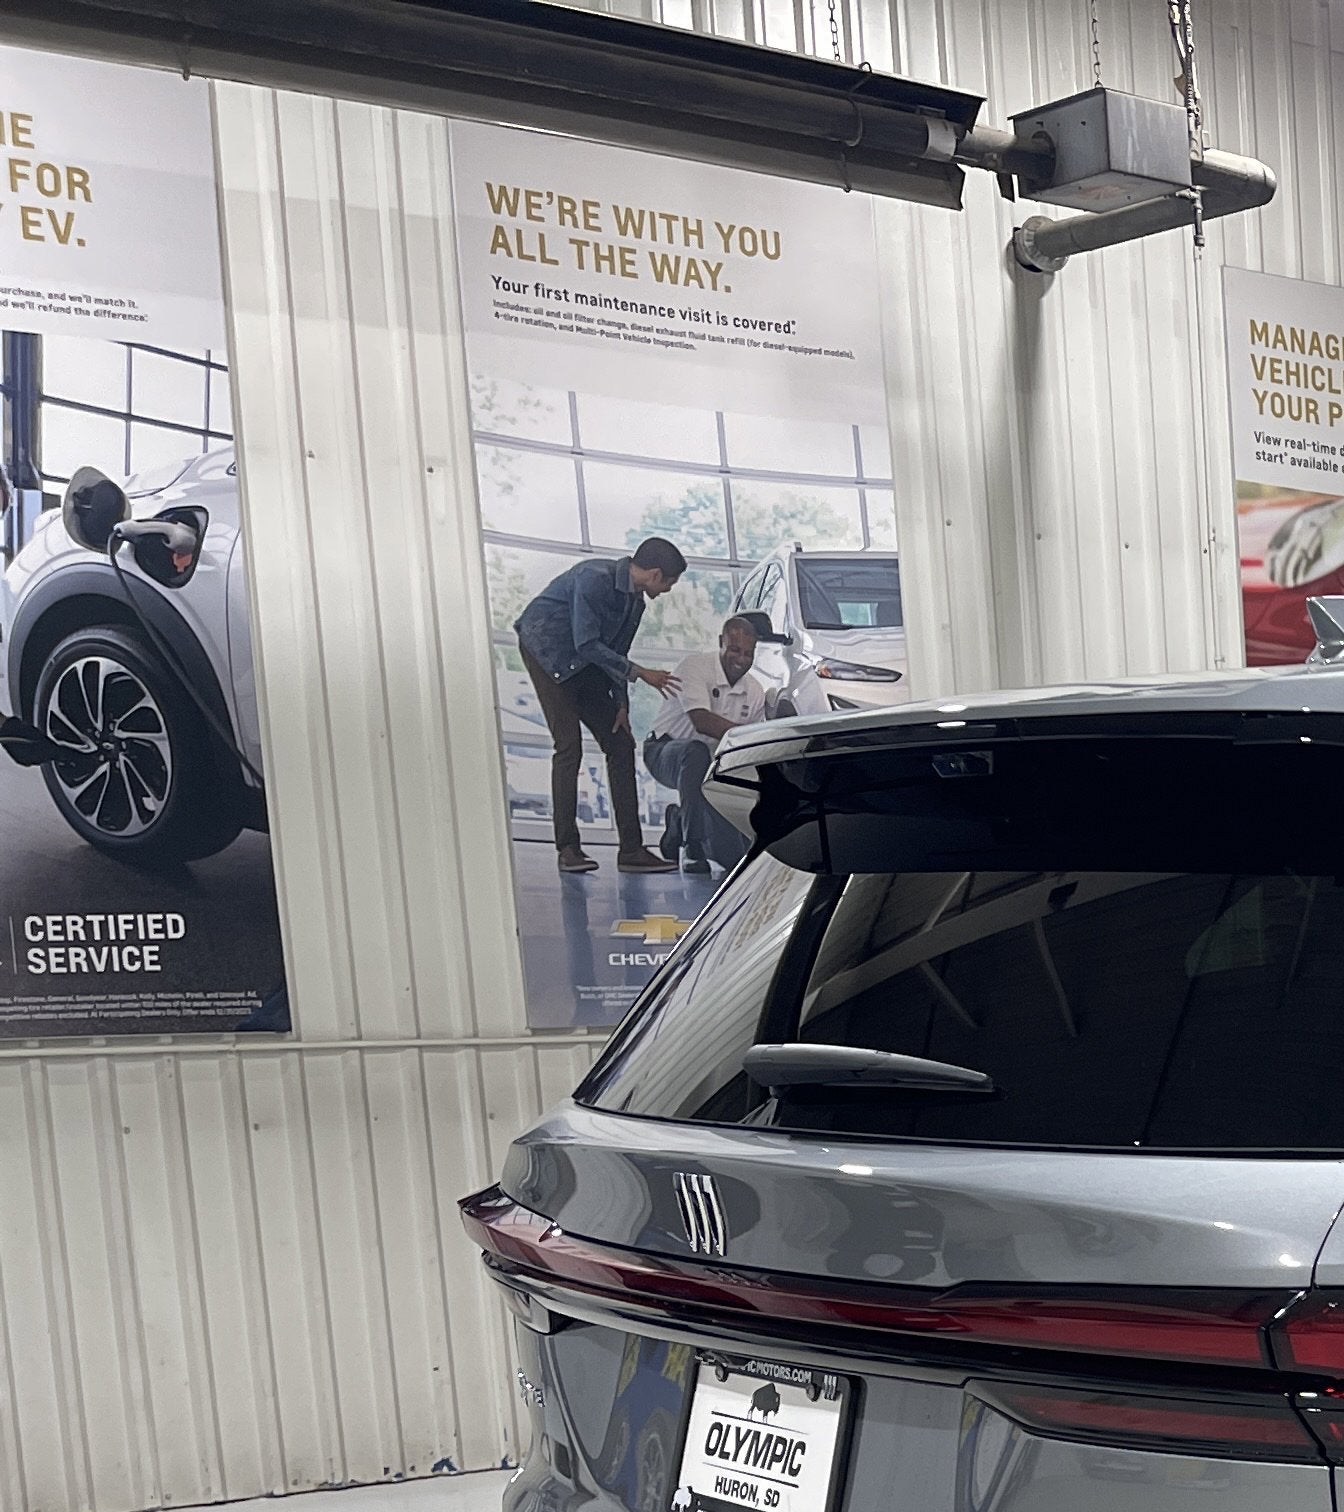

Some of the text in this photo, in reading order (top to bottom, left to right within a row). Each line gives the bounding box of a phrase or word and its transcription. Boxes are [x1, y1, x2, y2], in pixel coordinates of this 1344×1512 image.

[0, 111, 35, 149] E
[8, 158, 92, 203] FOR
[20, 205, 86, 247] EV.
[484, 182, 782, 261] WE'RE WITH YOU
[490, 225, 732, 293] ALL THE WAY.
[0, 288, 45, 299] urchase,
[48, 292, 66, 301] and
[94, 298, 125, 307] match
[38, 304, 71, 314] refund
[74, 307, 90, 316] the
[491, 275, 529, 296] Your
[534, 282, 570, 302] first
[574, 291, 675, 319] maintenance
[678, 307, 712, 324] visit
[716, 311, 729, 326] is
[1252, 388, 1320, 425] YOUR
[1254, 431, 1282, 446] View
[1284, 438, 1337, 456] real-time
[1290, 456, 1339, 473] available
[24, 913, 187, 942] CERTIFIED
[27, 945, 162, 974] SERVICE
[704, 1421, 807, 1477] OLYMPIC
[714, 1475, 780, 1508] HURON, SD
